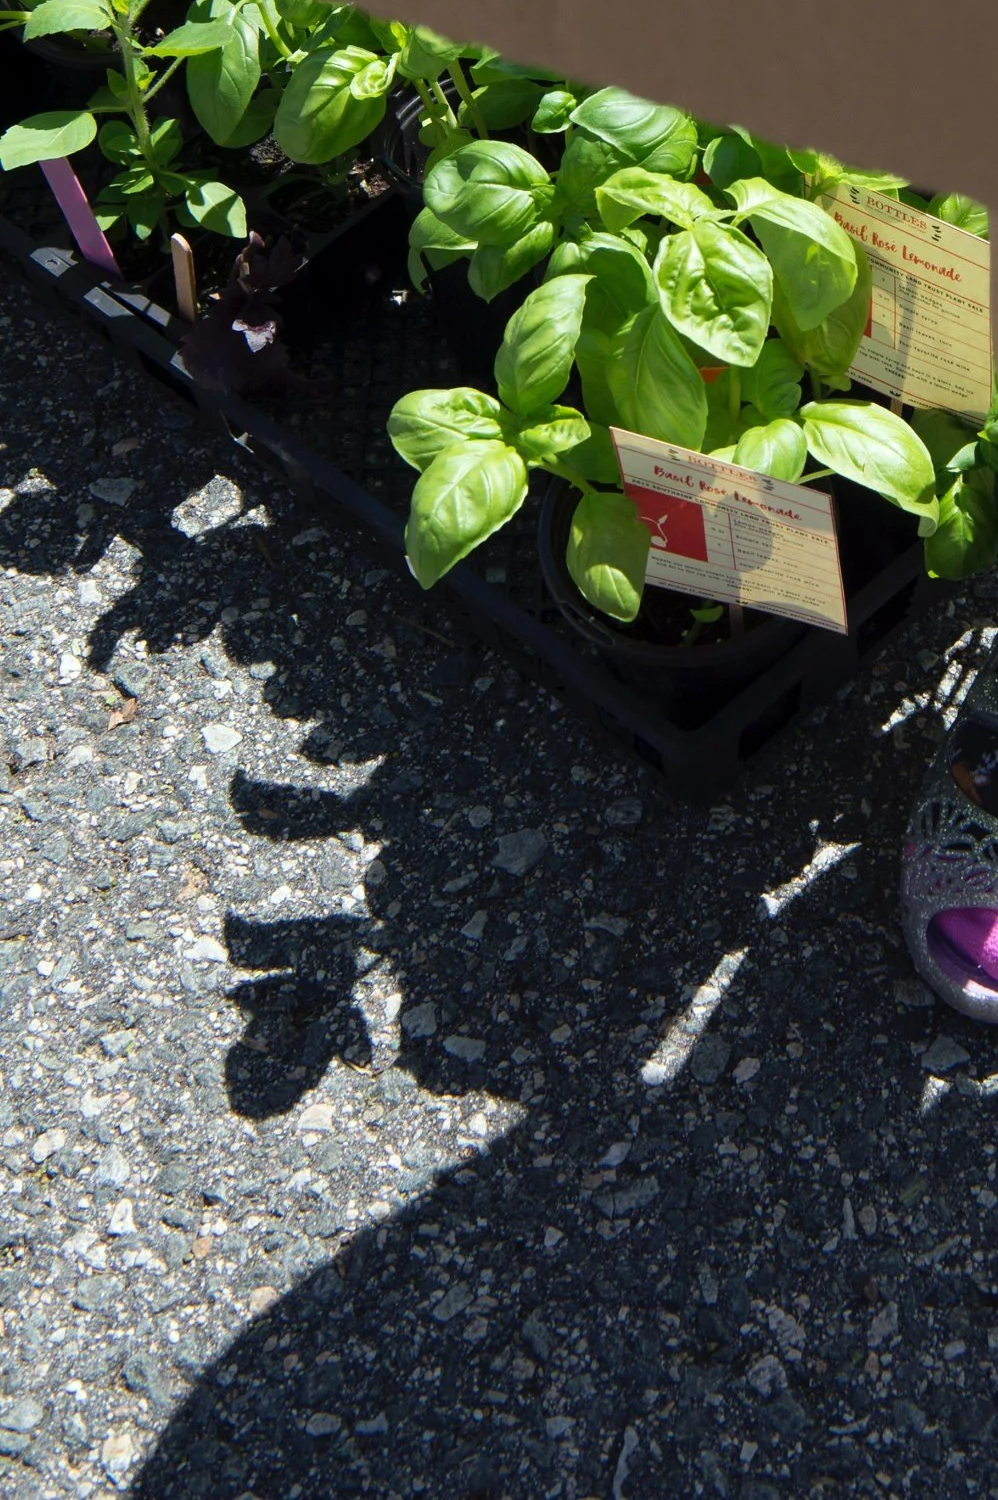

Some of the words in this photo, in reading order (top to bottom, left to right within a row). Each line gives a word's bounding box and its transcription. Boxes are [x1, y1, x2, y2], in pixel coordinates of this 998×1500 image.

[867, 196, 926, 230] BOTTLES
[835, 212, 867, 242] Basil
[903, 245, 961, 283] Lemonade
[867, 257, 903, 277] COMMUNITY
[906, 276, 921, 285] LAND
[924, 284, 943, 295] TRUST
[946, 294, 964, 305] PLANT
[968, 304, 982, 313] SALE
[653, 465, 695, 488] Basil
[734, 491, 802, 521] Lemonade
